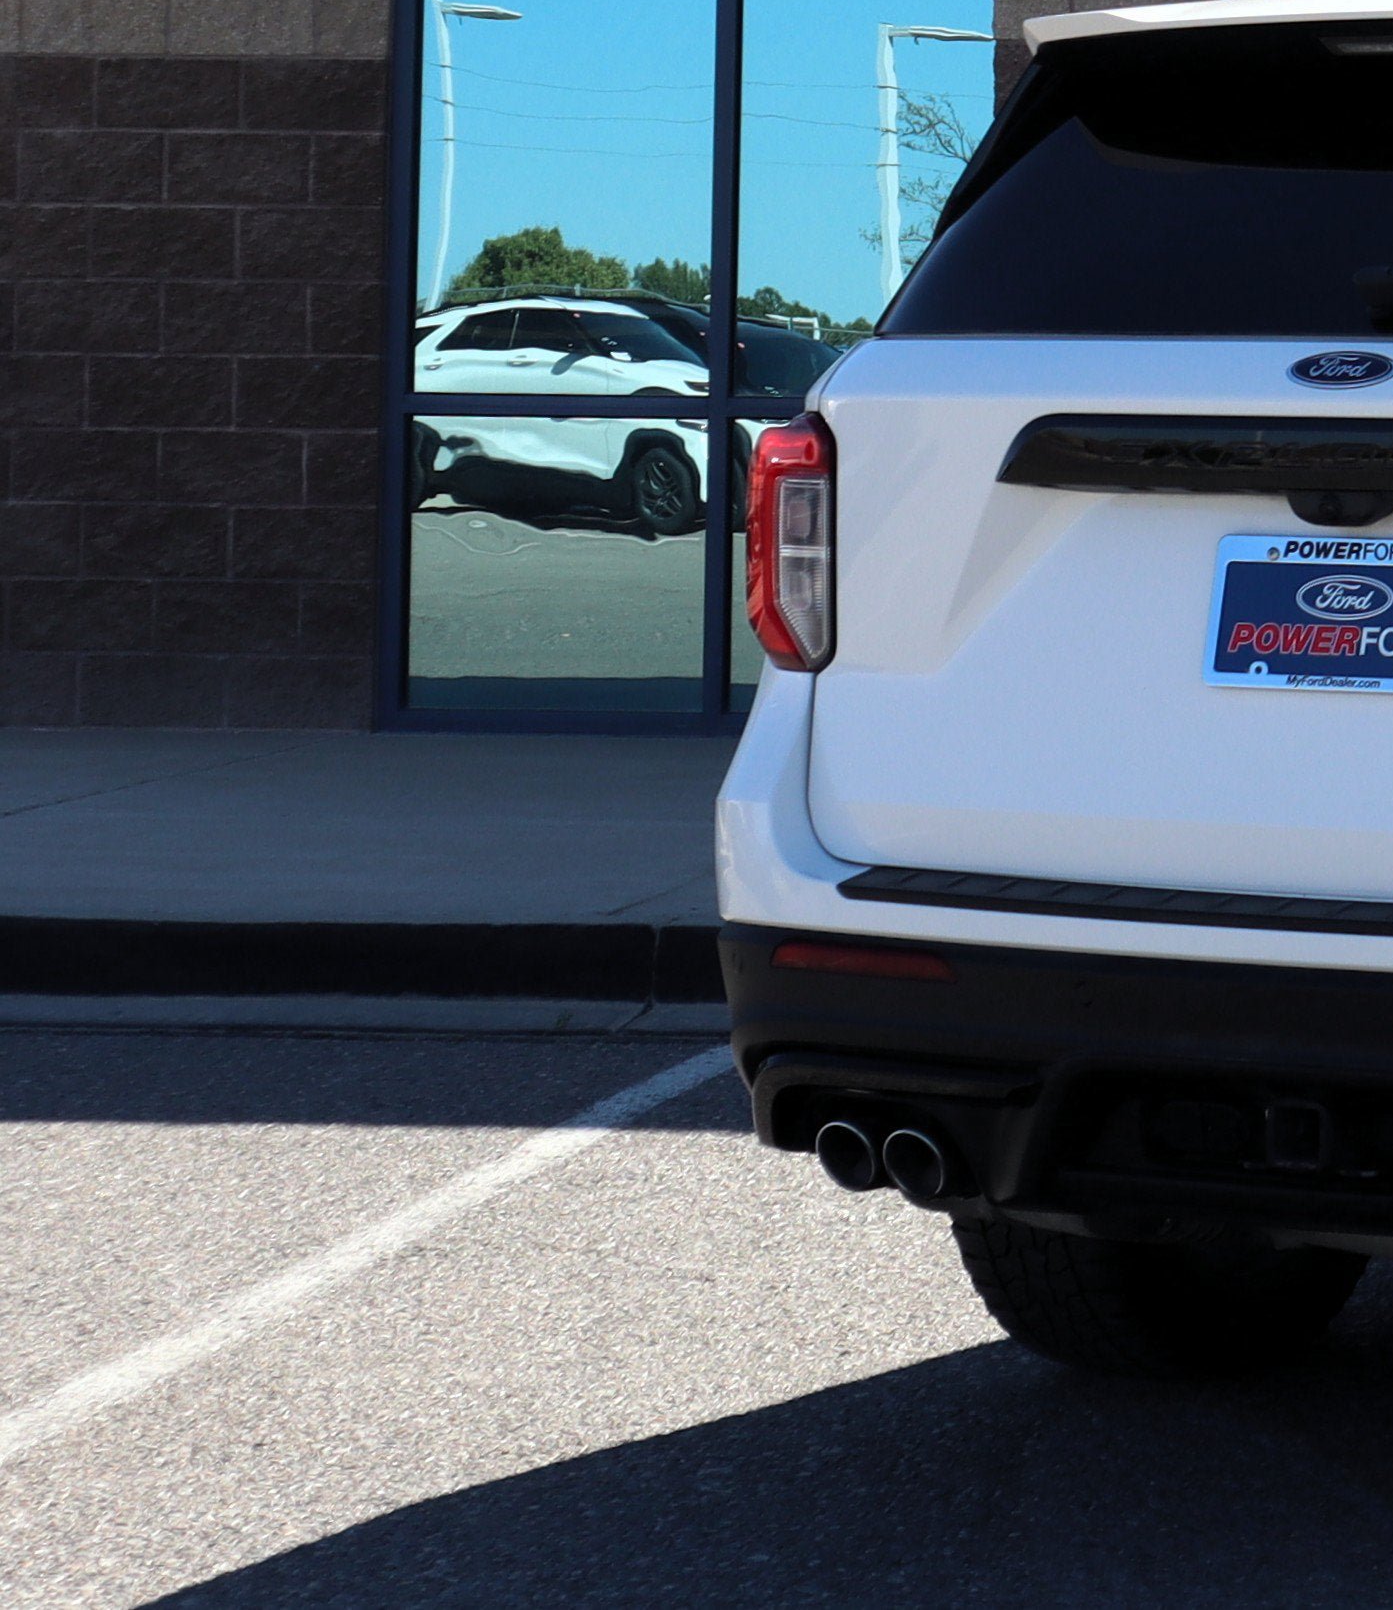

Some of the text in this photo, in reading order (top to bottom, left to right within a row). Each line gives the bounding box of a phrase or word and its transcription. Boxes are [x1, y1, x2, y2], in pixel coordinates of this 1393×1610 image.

[1309, 355, 1373, 378] Ford
[1314, 581, 1375, 611] Ford
[1286, 674, 1381, 688] MyFordDealer.com
